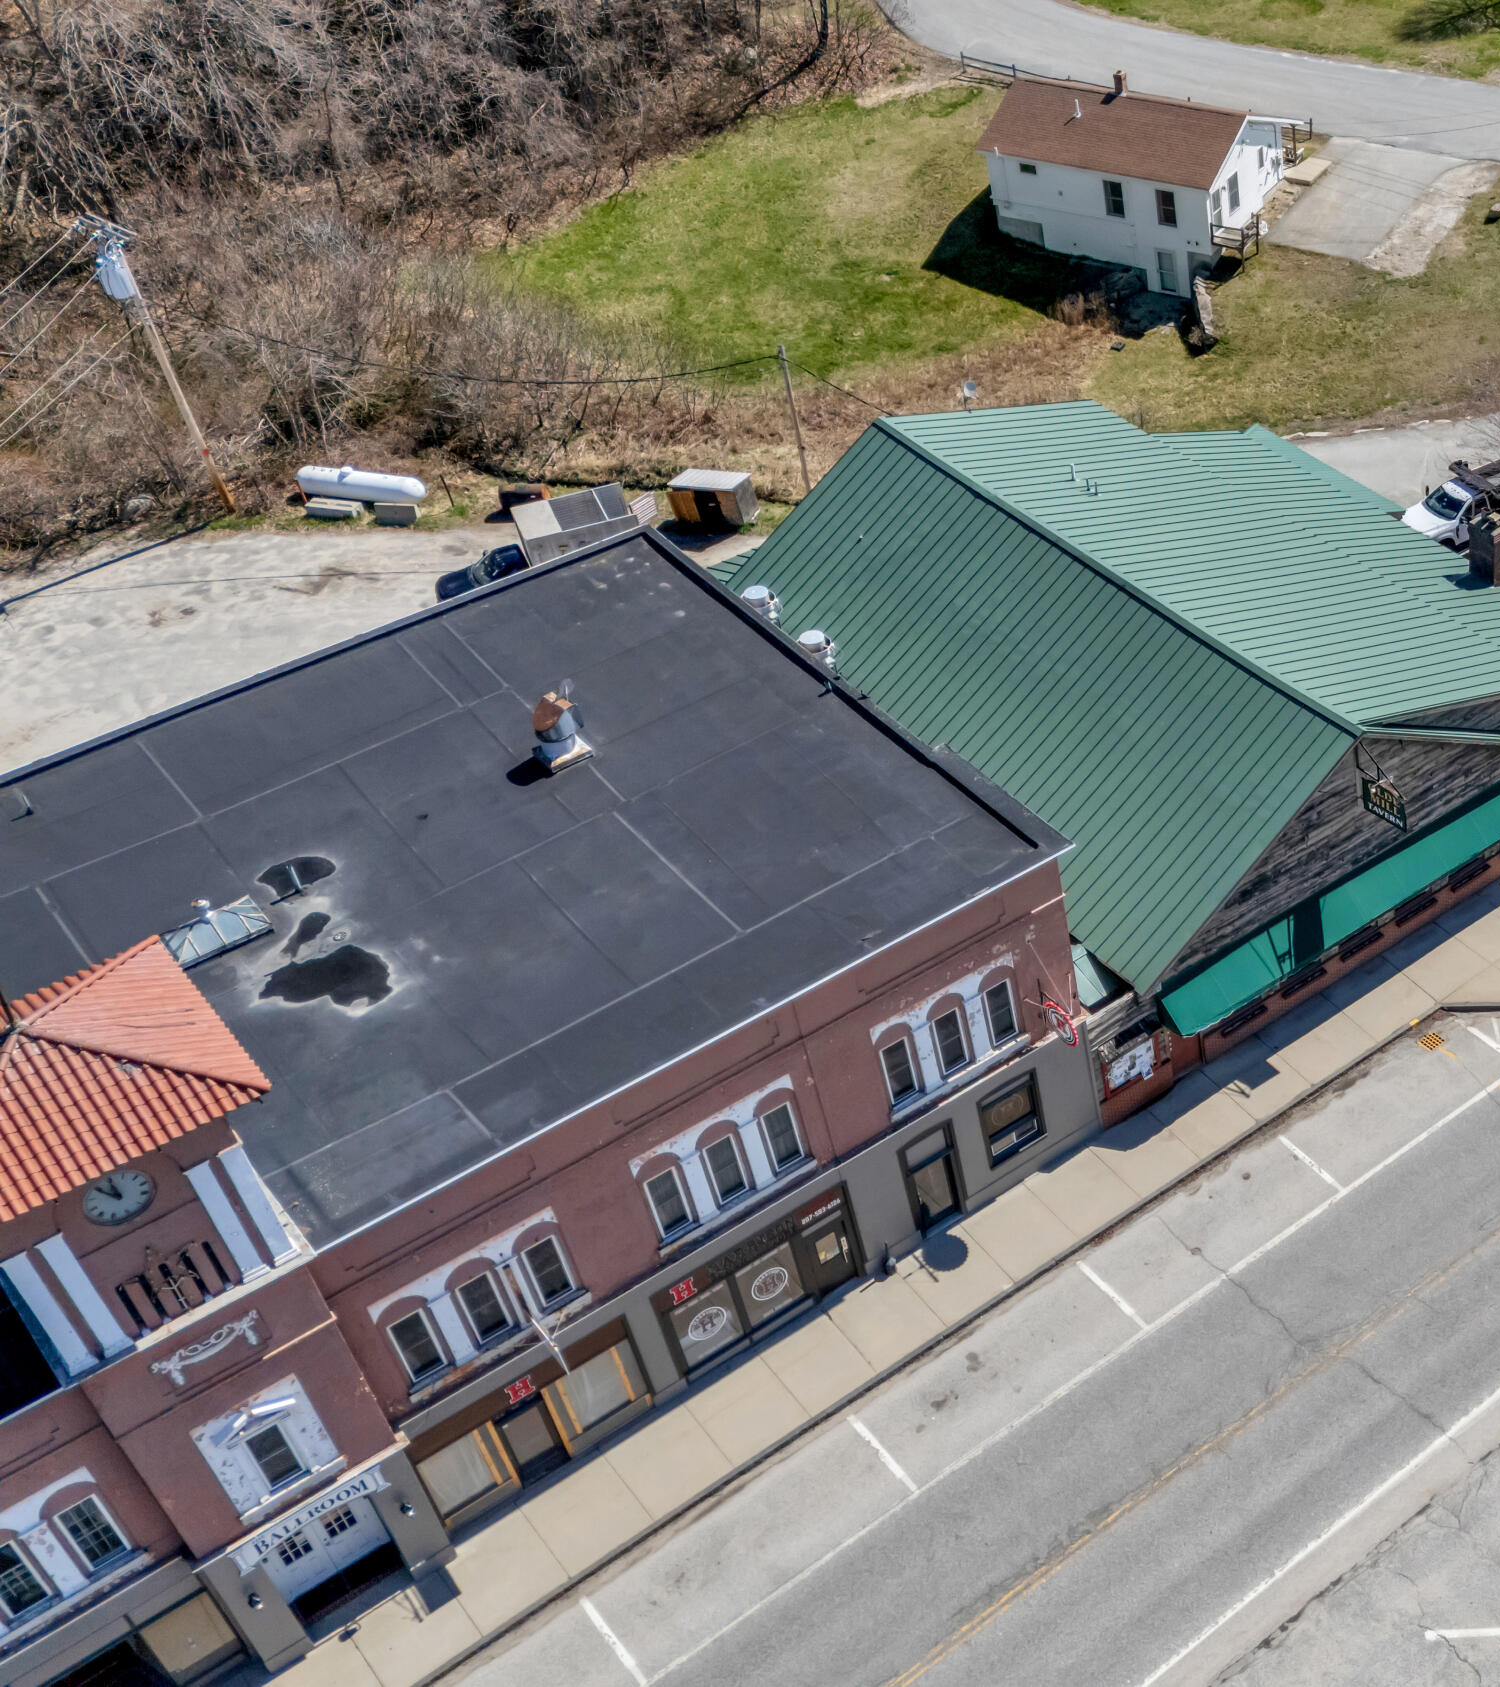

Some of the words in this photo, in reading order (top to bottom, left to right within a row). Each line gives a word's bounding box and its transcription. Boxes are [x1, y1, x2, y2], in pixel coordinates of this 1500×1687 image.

[1367, 801, 1403, 828] TAVERN
[1370, 793, 1401, 817] MILL
[669, 1277, 697, 1305] H
[504, 1375, 536, 1404] H
[254, 1479, 369, 1555] BALLROOM
